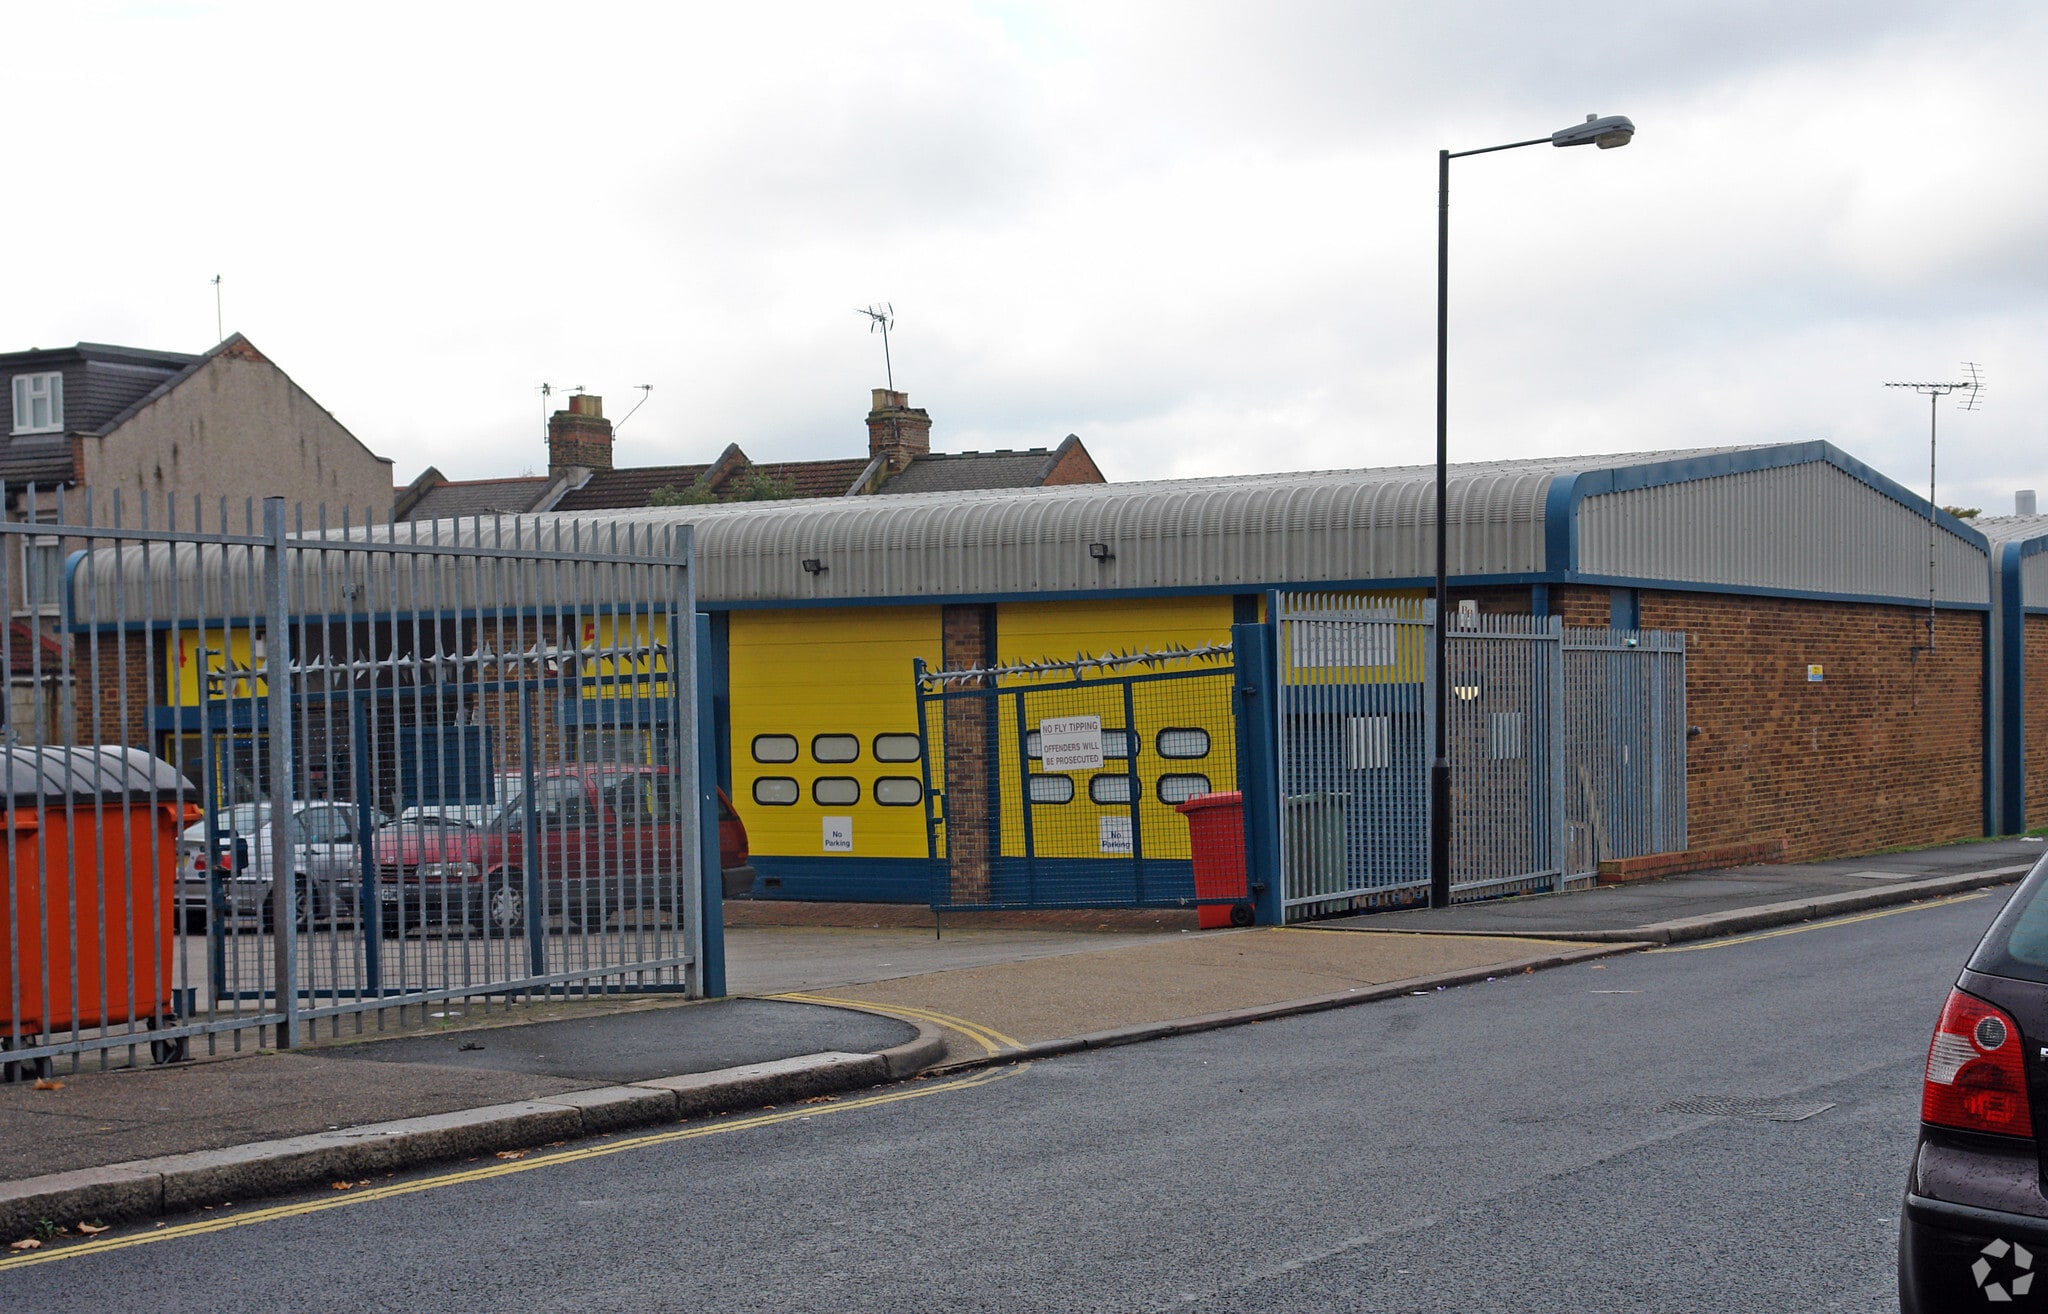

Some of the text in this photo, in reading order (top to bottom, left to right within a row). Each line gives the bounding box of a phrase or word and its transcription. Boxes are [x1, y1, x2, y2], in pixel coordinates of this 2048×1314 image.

[1042, 721, 1098, 733] NO FLY TIPPING
[1044, 741, 1100, 753] OFFENDERS WILL
[1046, 754, 1099, 766] BE PROSECUTED
[1111, 830, 1122, 839] No
[825, 839, 850, 848] Parking
[1102, 840, 1131, 850] Parking
